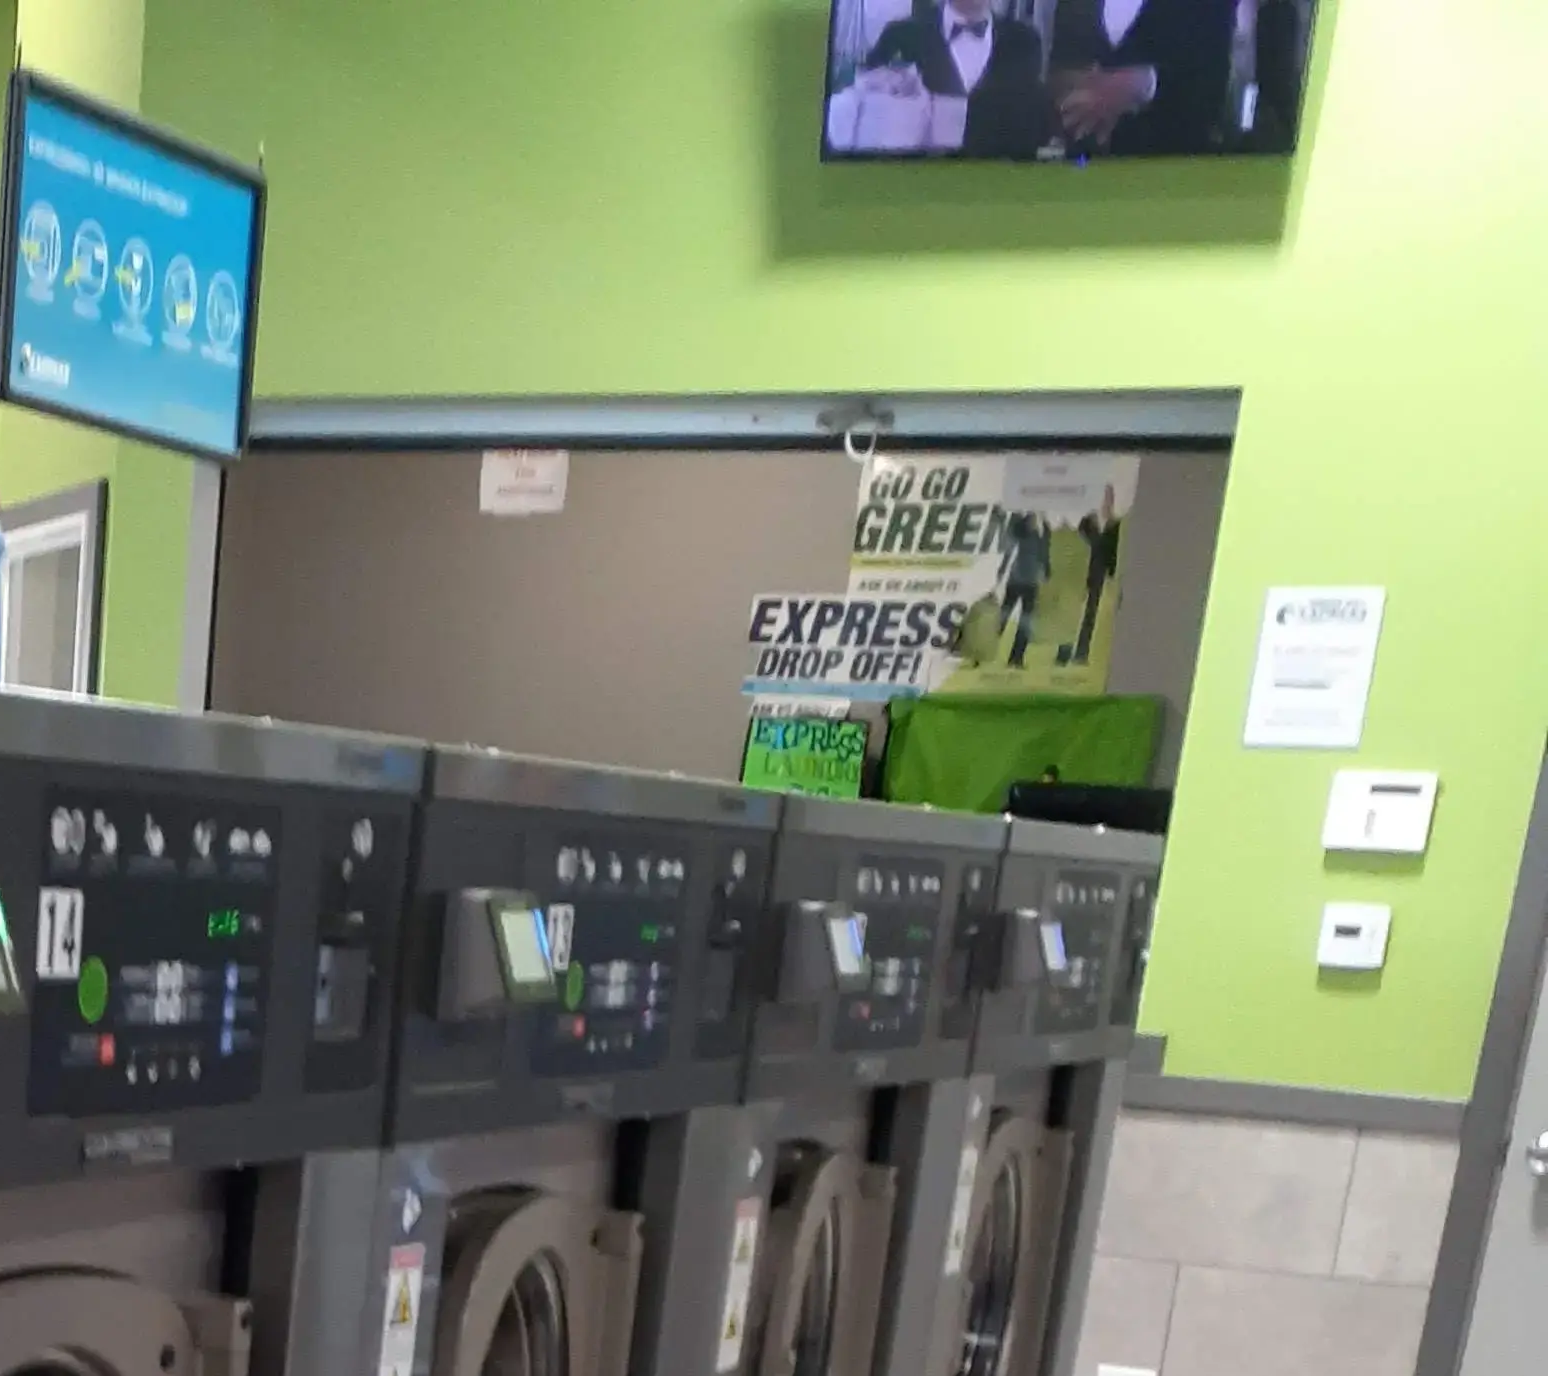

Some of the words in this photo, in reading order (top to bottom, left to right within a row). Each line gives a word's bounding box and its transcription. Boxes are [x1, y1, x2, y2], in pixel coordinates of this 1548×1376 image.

[870, 467, 914, 500] GO
[922, 467, 970, 500] GO
[854, 502, 1010, 553] GREEN
[749, 600, 967, 650] EXPRESS
[756, 648, 844, 679] DROP
[850, 651, 922, 684] OFF!
[755, 719, 865, 762] EXPRESS
